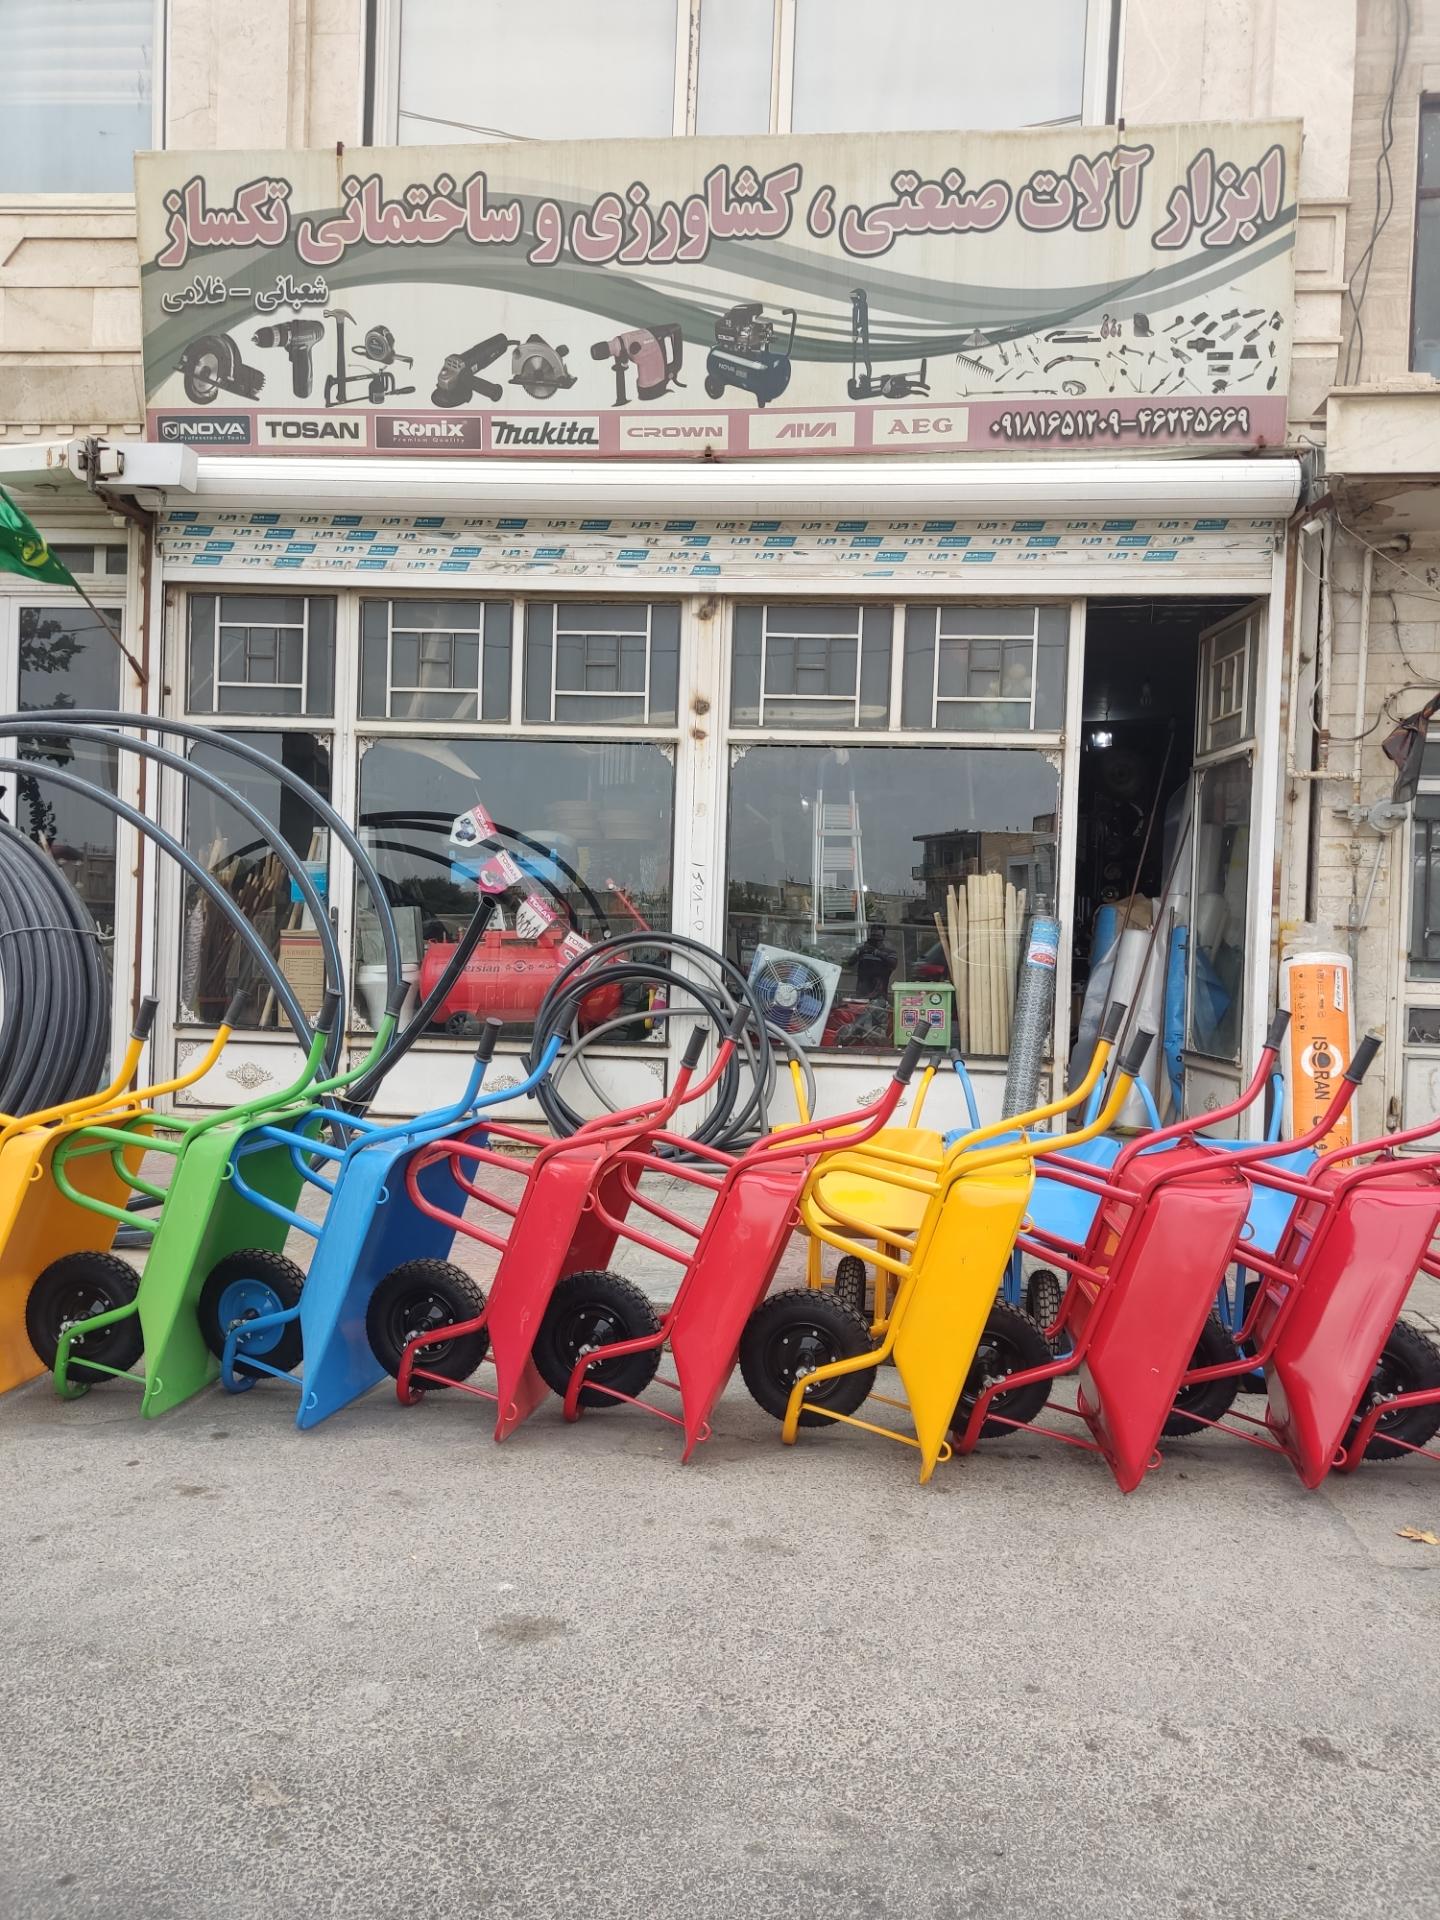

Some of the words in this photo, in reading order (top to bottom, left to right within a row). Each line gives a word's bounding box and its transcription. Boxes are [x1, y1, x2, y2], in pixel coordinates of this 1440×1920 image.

[1016, 145, 1155, 231] آلات
[1152, 143, 1287, 250] ابزار
[154, 174, 293, 270] تکساز
[297, 171, 523, 269] ساختمانی
[526, 197, 563, 267] و
[570, 162, 803, 267] کشاورزی
[161, 274, 227, 313] غلامی
[254, 274, 330, 312] شعبانی
[180, 422, 246, 435] NOVA
[265, 420, 360, 440] TOSAN
[392, 419, 465, 438] Ronix
[627, 426, 723, 438] CROWN
[887, 418, 954, 435] AEG
[474, 806, 492, 835] TOSAN
[528, 896, 553, 922] TOSAN
